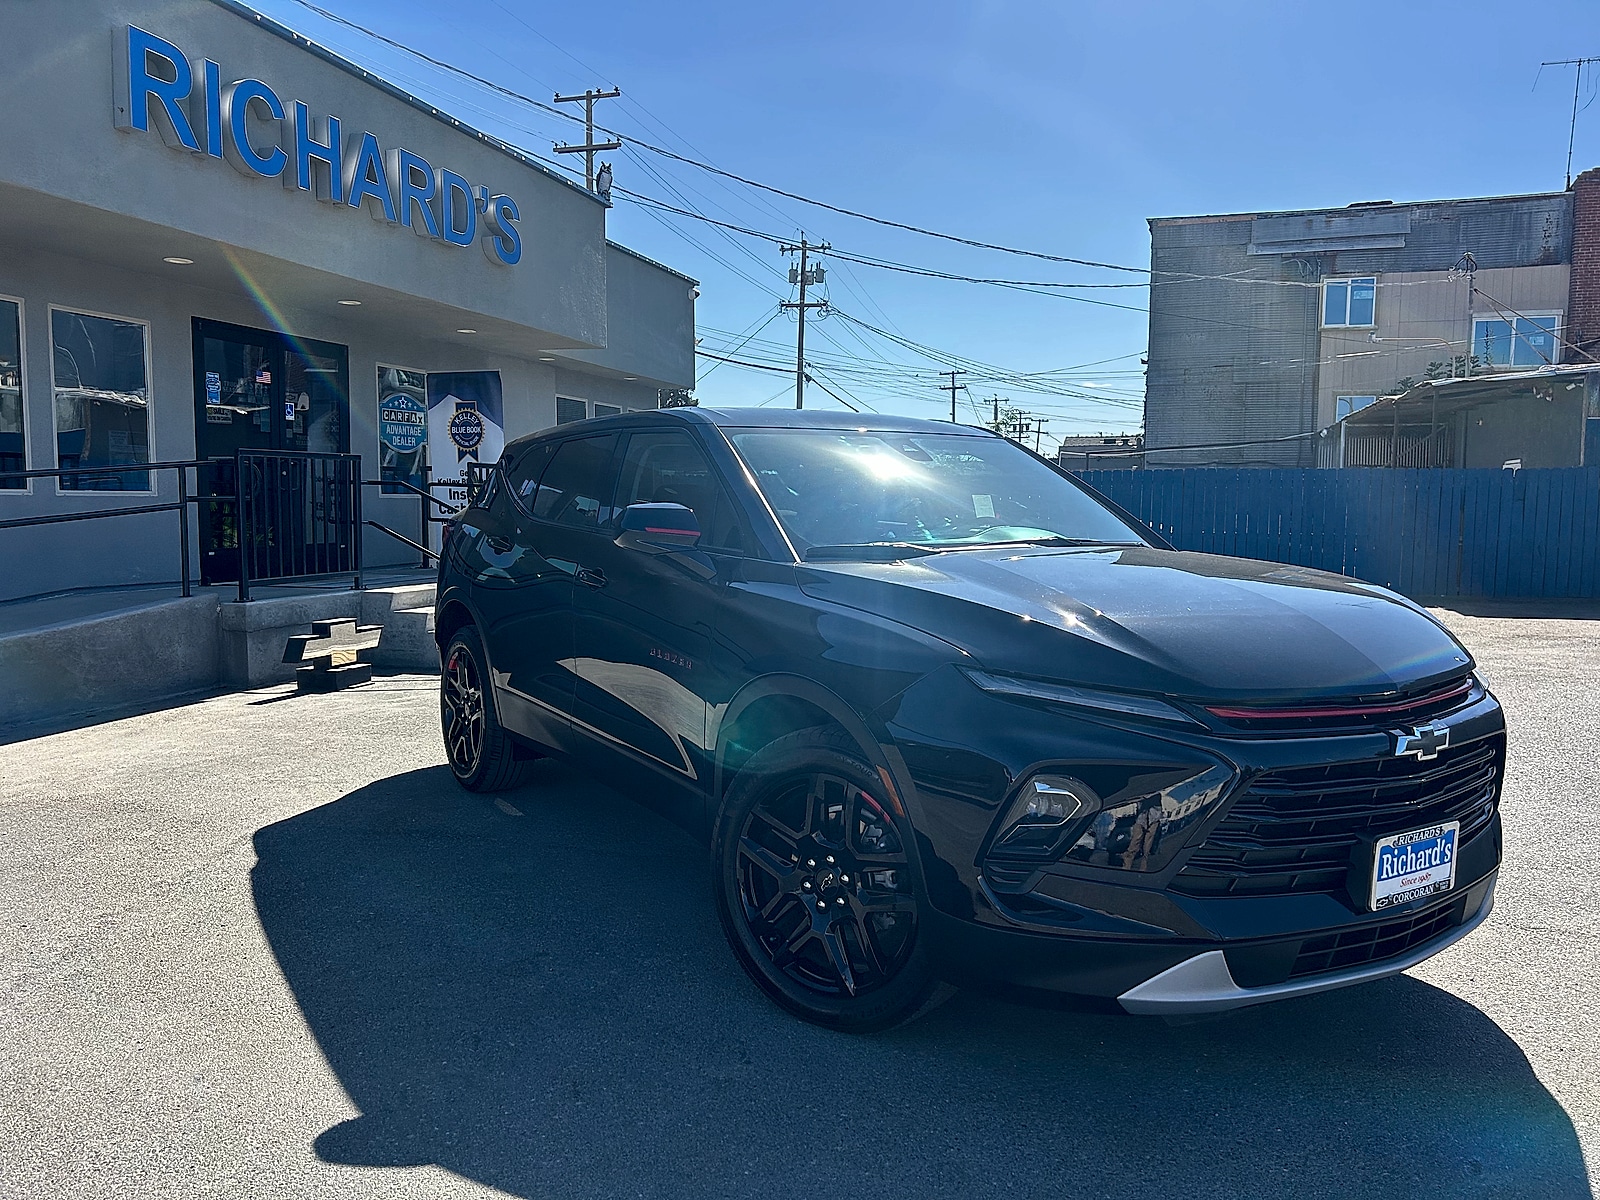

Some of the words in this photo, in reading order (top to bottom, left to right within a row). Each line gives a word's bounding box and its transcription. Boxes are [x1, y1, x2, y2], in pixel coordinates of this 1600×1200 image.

[127, 23, 523, 267] RICHARD'S
[383, 411, 423, 425] CARFAX
[454, 413, 479, 425] KELLEY
[386, 424, 422, 437] ADVANTAGE
[452, 426, 466, 434] BLUE
[467, 426, 482, 434] BOOK
[392, 435, 416, 448] DEALER
[649, 648, 691, 670] BLAZER
[1381, 838, 1451, 879] Richard's
[1400, 877, 1418, 887] Since
[1393, 884, 1435, 904] CORCORAN
